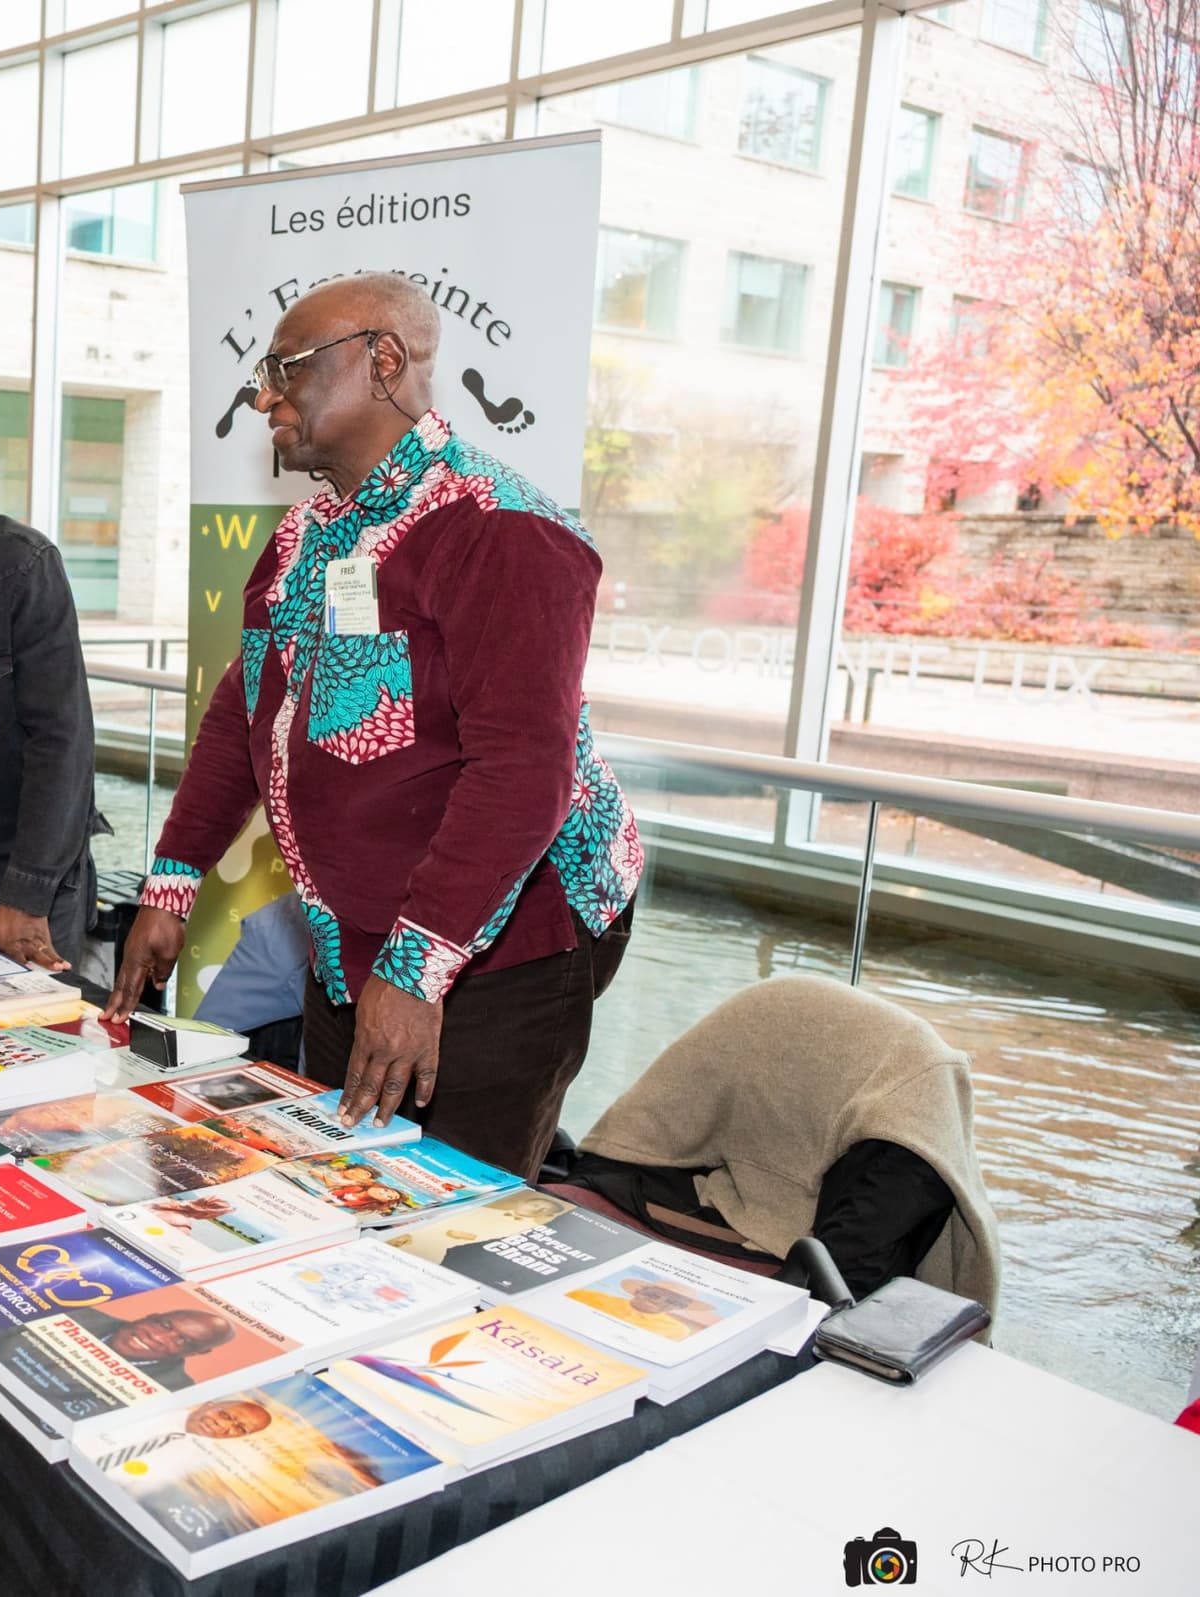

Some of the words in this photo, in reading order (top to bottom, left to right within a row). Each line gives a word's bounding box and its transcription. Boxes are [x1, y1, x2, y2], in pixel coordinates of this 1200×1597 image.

[270, 205, 324, 235] Les
[336, 192, 472, 229] éditions
[269, 267, 512, 348] Eeinte
[973, 651, 1108, 710] LUX
[276, 1103, 355, 1141] L'Hôpital
[524, 1228, 596, 1262] L'APPELAIT
[534, 1225, 559, 1236] ON
[482, 1240, 560, 1275] Cham
[506, 1236, 568, 1264] Boss
[251, 1322, 285, 1343] Joseph
[54, 1320, 159, 1396] Pharmagros
[478, 1318, 600, 1387] Kasàlà
